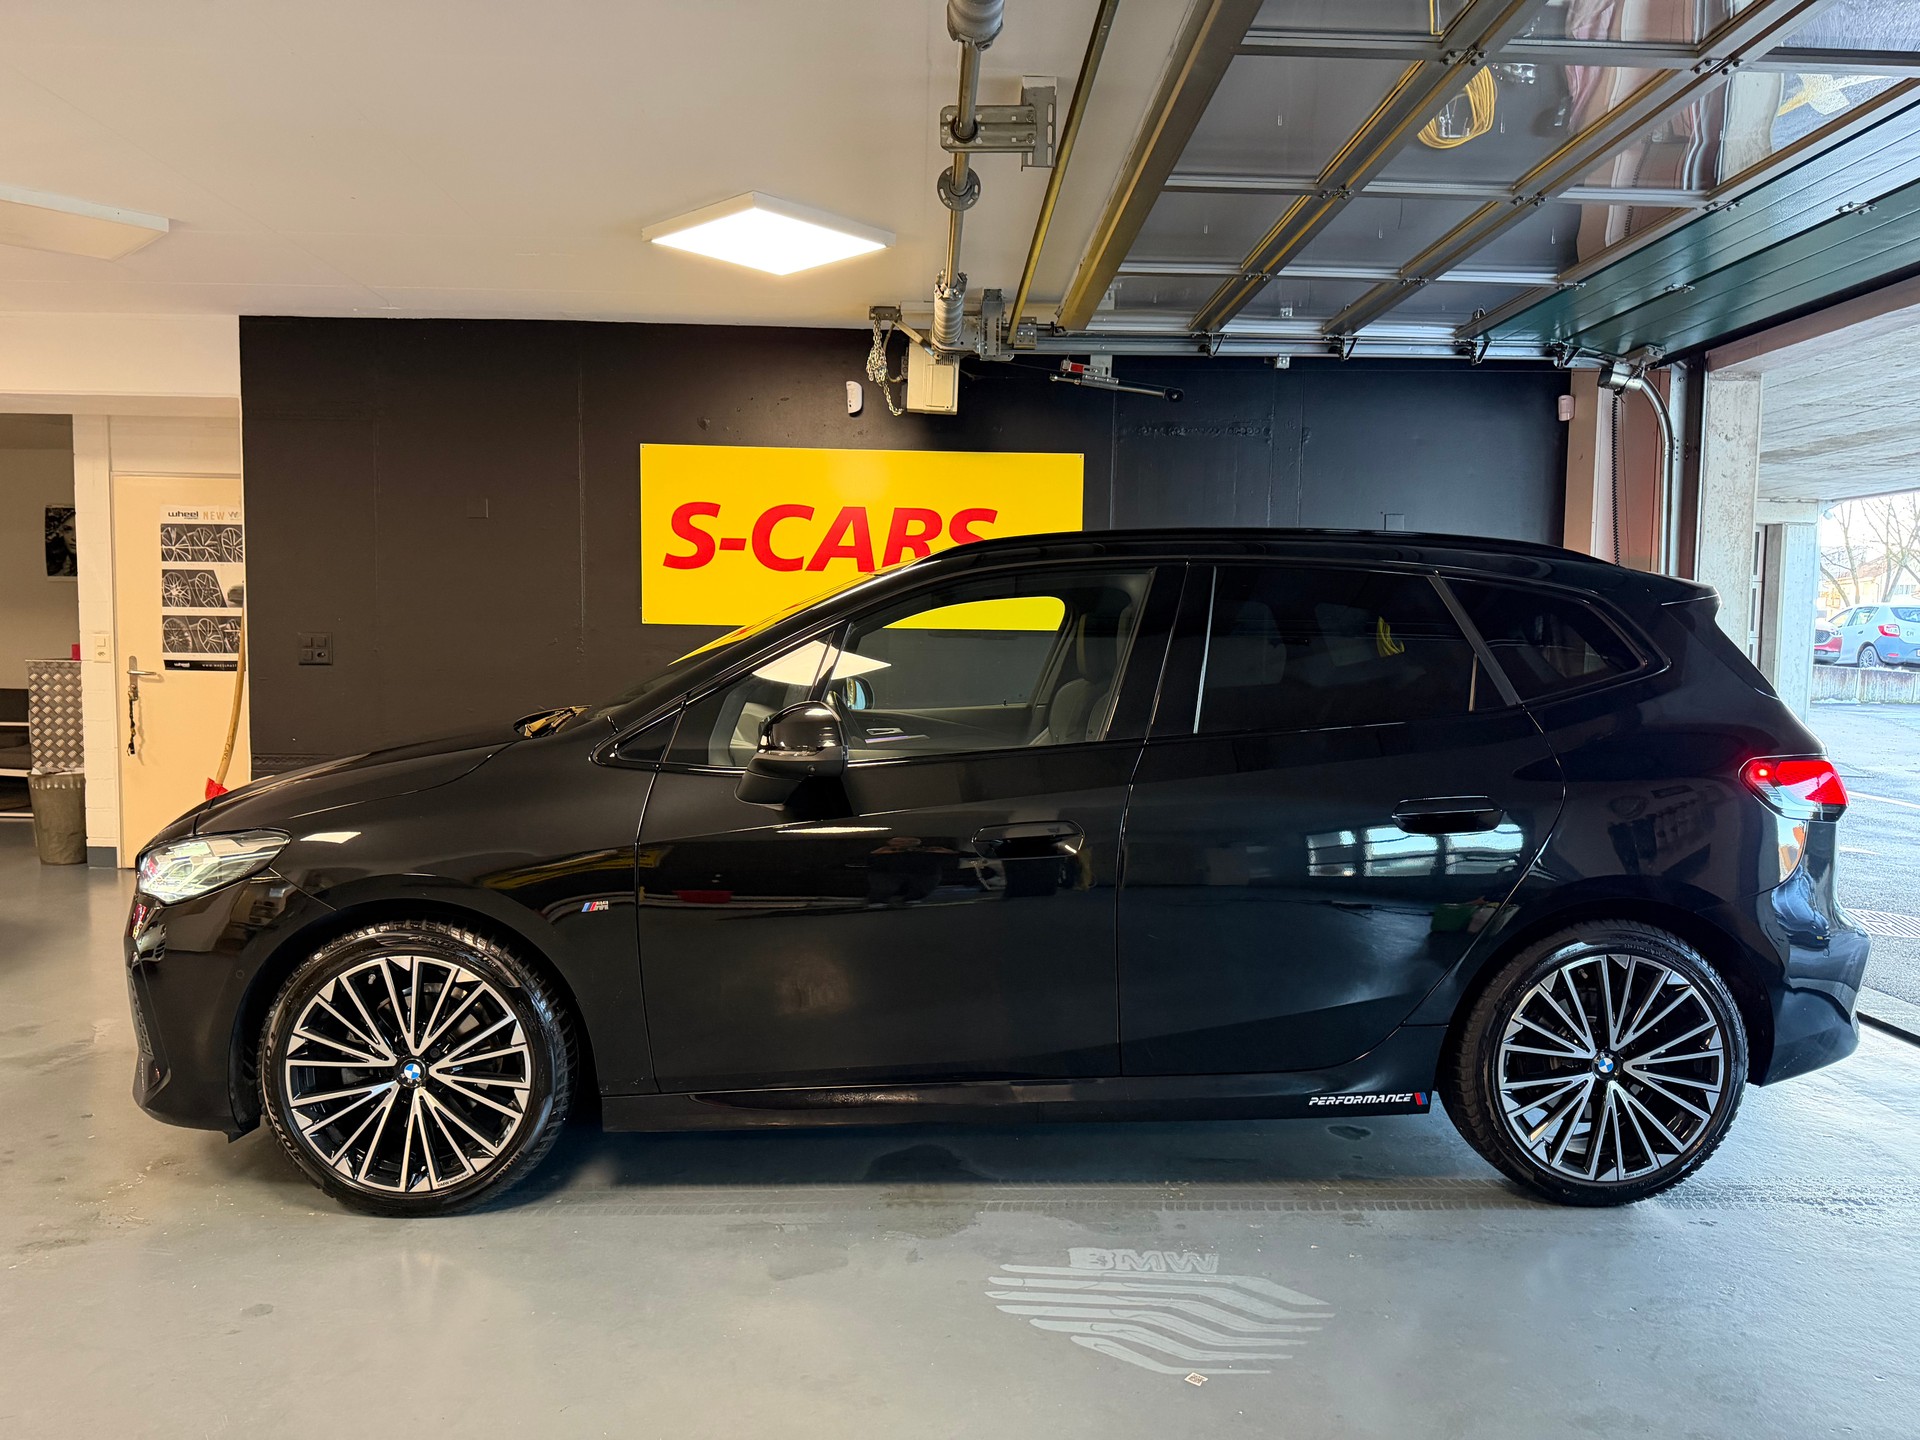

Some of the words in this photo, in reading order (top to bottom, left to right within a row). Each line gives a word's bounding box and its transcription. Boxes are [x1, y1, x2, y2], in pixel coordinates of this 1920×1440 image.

[168, 510, 199, 518] wheel
[203, 511, 225, 521] NEW
[1308, 1093, 1414, 1106] PERFORMANCE
[1067, 1247, 1220, 1274] BMW
